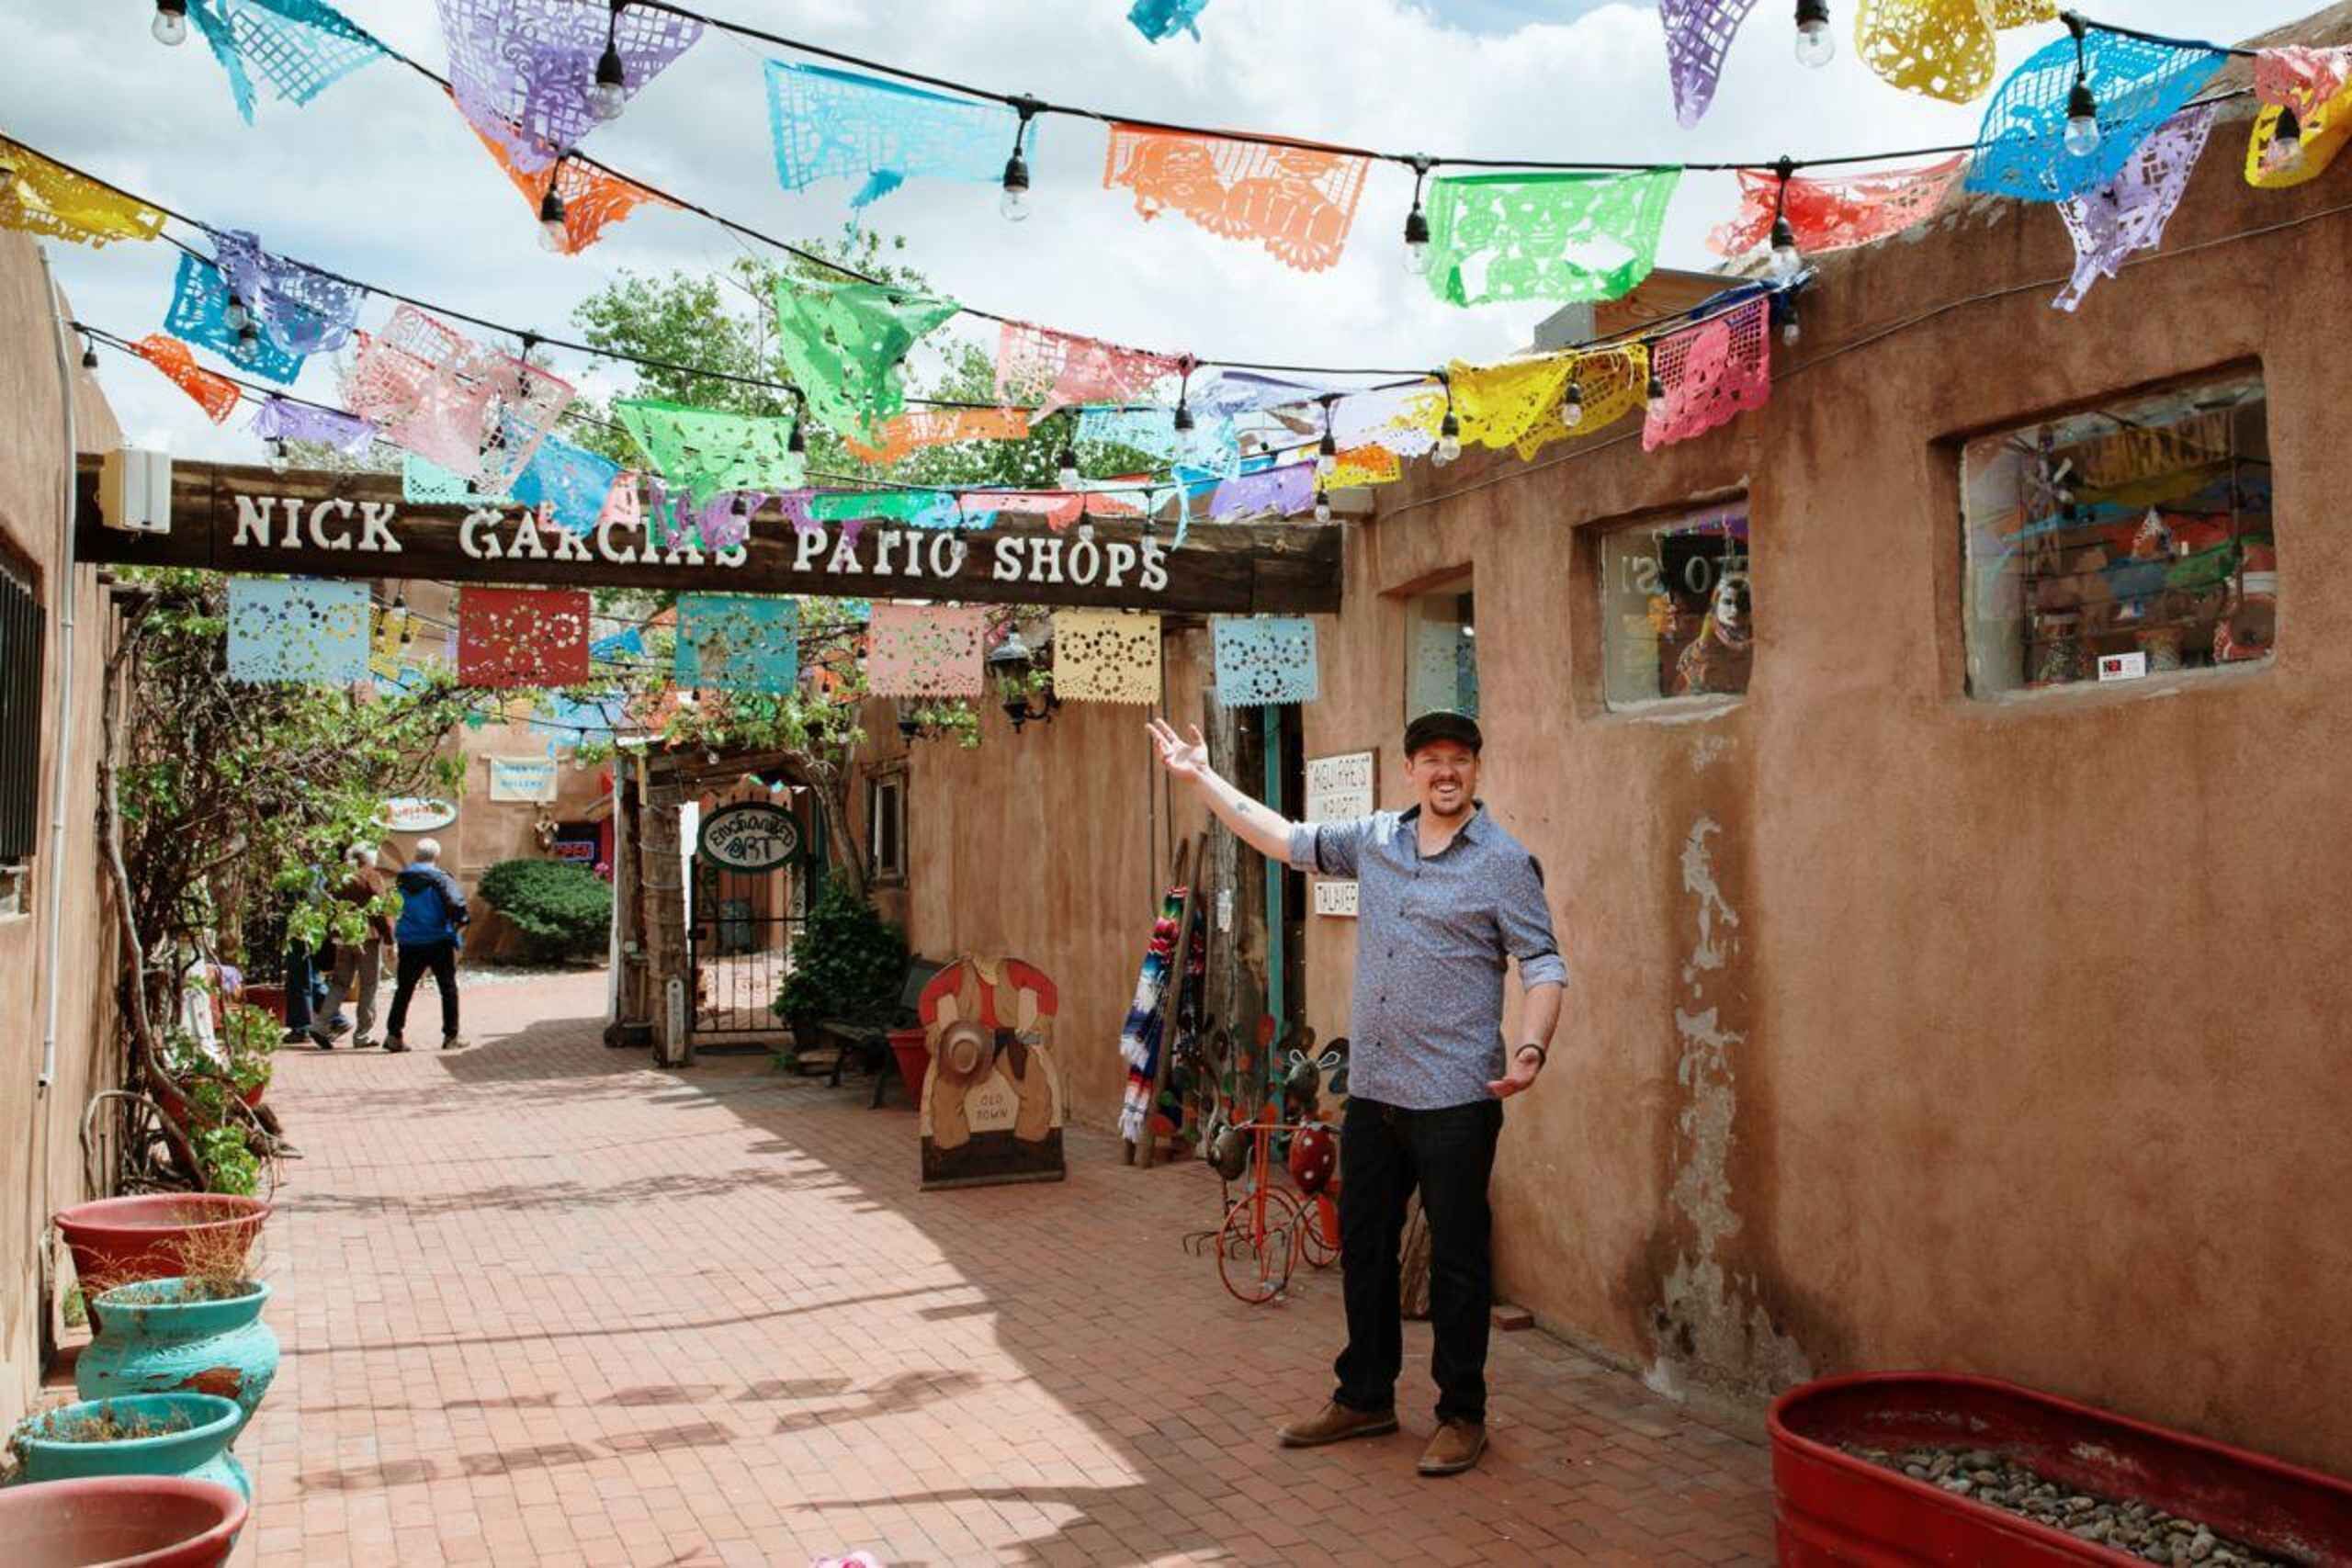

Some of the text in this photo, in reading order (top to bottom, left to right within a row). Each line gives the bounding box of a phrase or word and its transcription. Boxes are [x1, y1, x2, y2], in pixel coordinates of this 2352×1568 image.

[232, 495, 1169, 592] NICK GARCIS PATIO SHOPS
[724, 835, 785, 862] ART
[979, 1092, 1004, 1107] OLD
[977, 1109, 1008, 1120] TOWN
